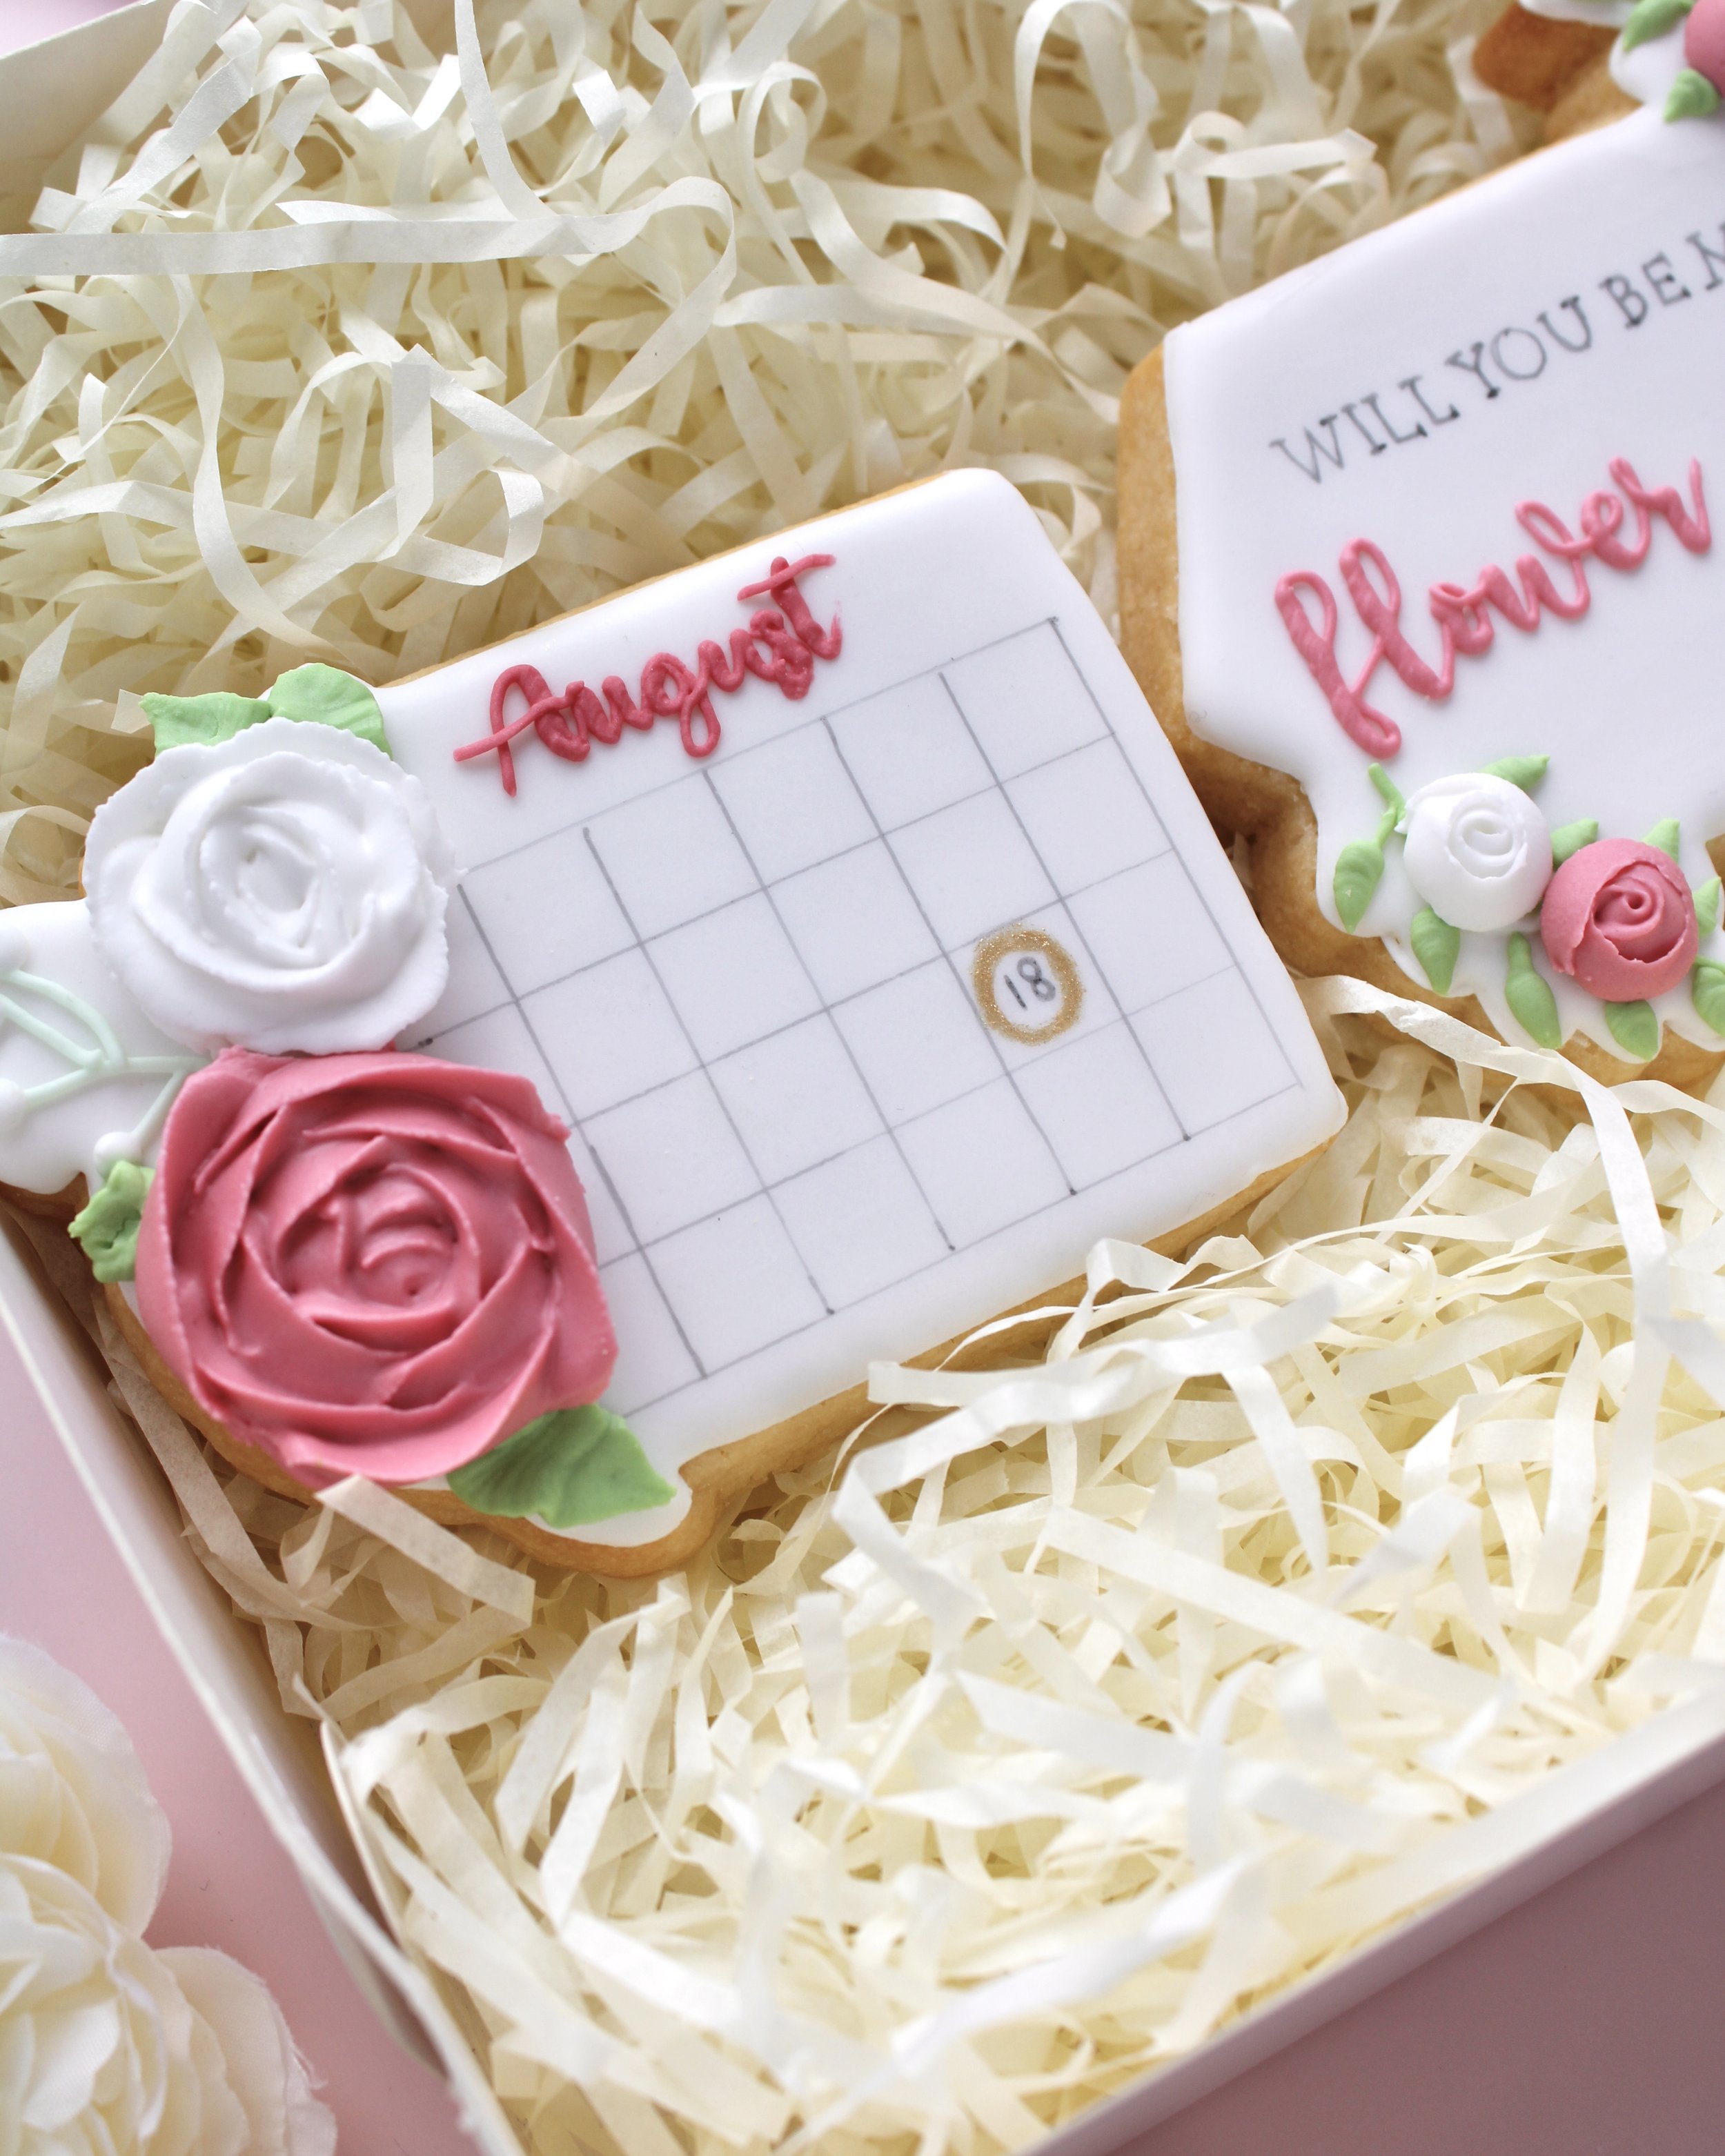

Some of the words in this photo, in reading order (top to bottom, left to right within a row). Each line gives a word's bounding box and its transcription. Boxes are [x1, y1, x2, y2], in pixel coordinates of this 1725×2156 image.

[1269, 375, 1460, 484] WILL
[1446, 295, 1593, 399] YOU
[1599, 252, 1691, 328] BE
[453, 554, 843, 797] August
[1274, 455, 1712, 760] flower
[1004, 956, 1056, 1011] 18
